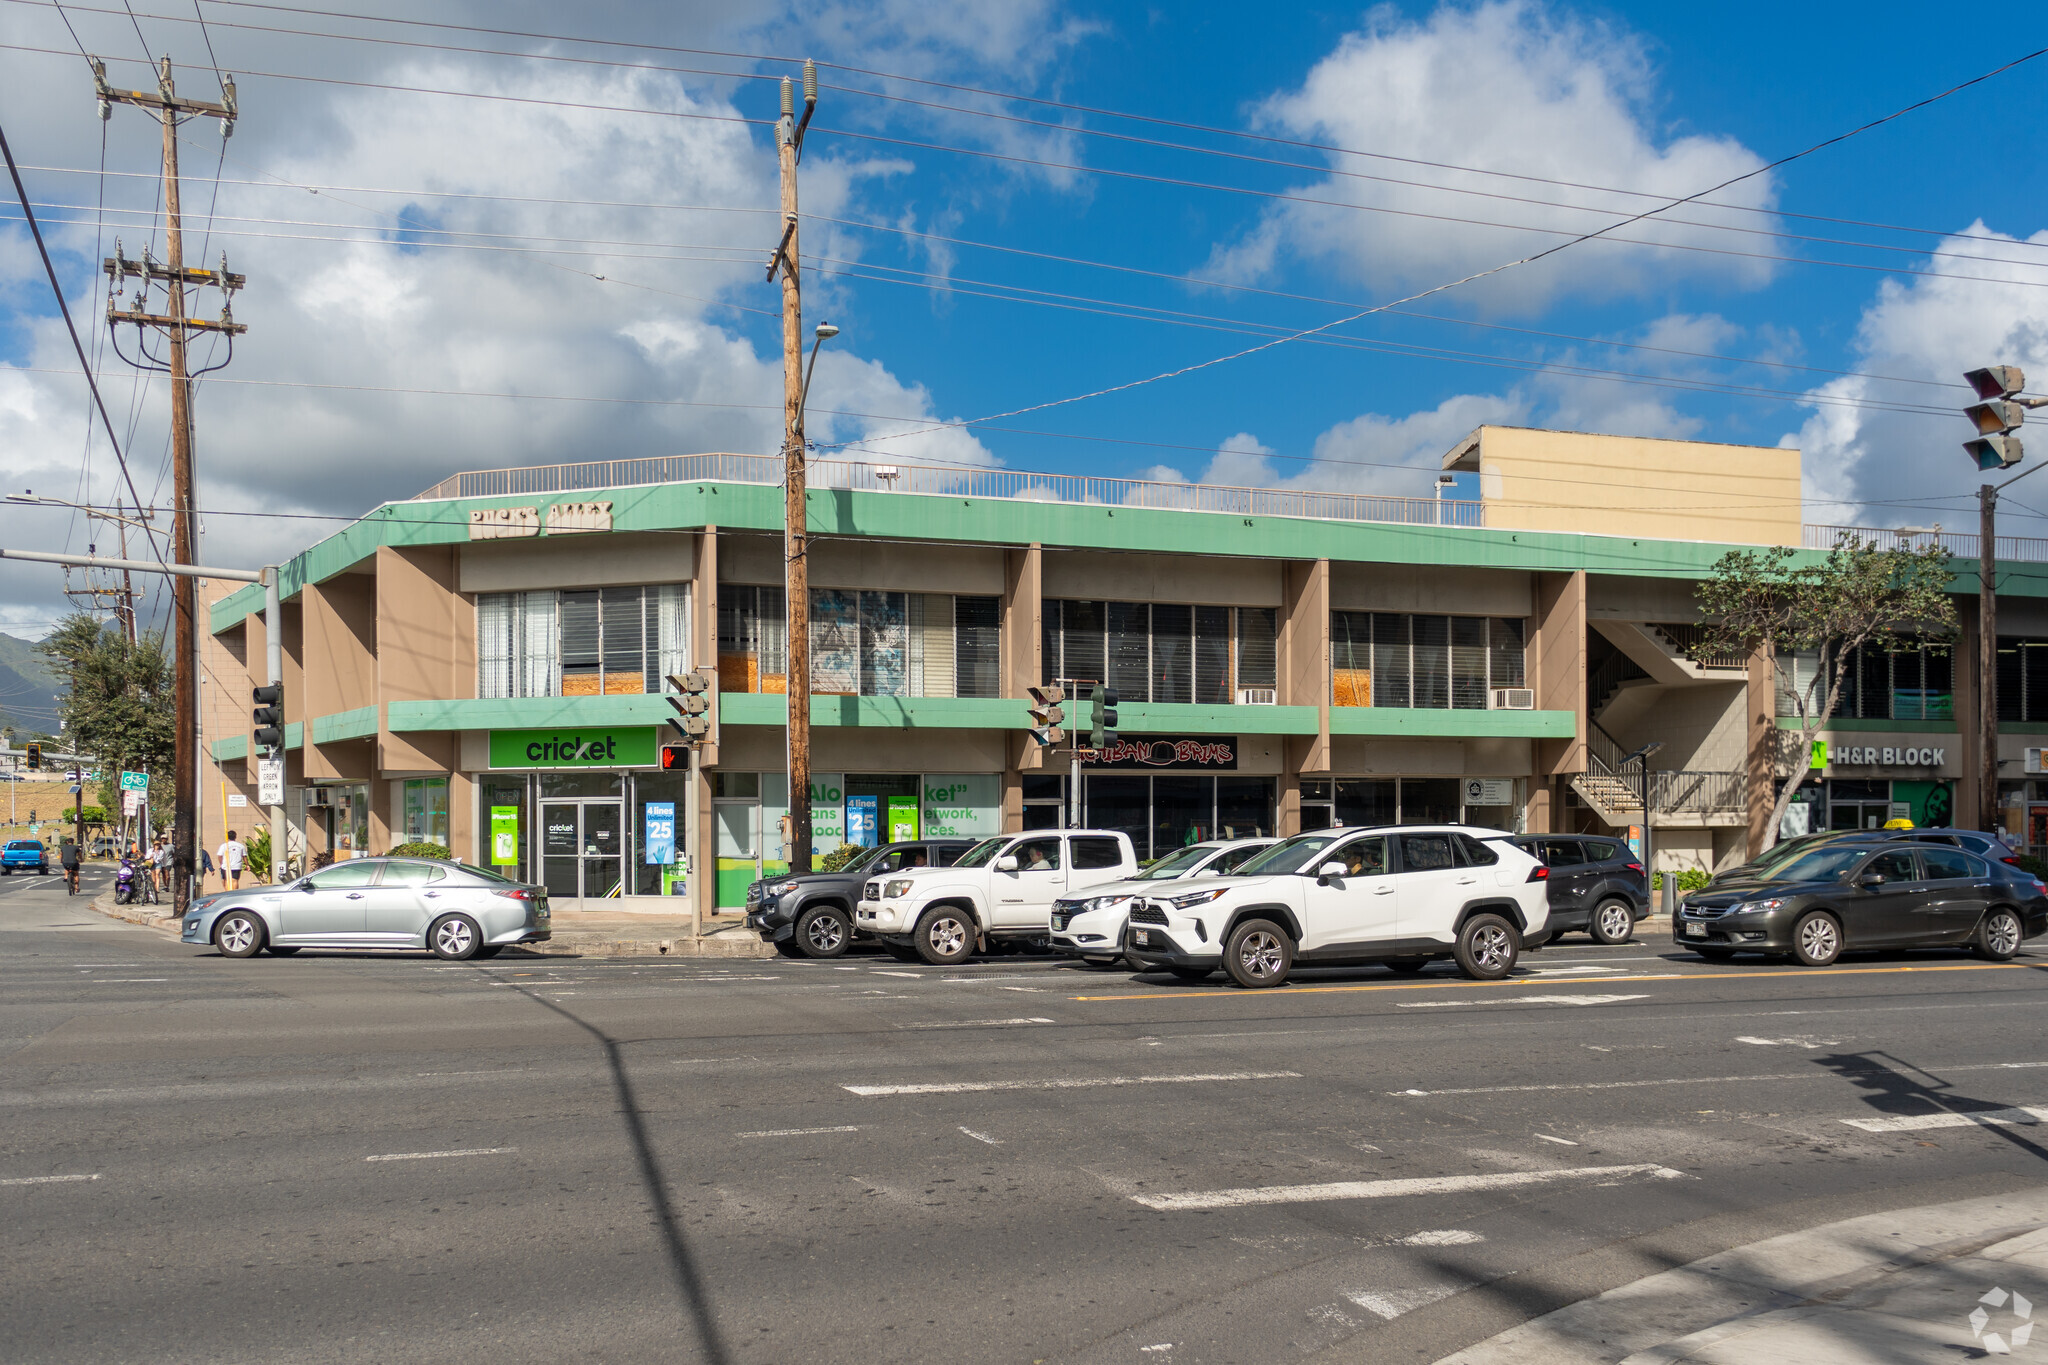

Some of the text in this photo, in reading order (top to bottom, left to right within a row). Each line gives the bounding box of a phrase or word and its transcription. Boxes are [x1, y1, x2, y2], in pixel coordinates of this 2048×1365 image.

[469, 501, 614, 540] PUCK'S ALLEY
[526, 735, 616, 761] cricket
[1175, 740, 1234, 764] BRIMS
[1835, 746, 1945, 766] H&R BLOCK
[261, 763, 281, 771] LEFT ON
[263, 773, 278, 781] GREEN
[264, 792, 277, 801] ONLY
[496, 791, 519, 802] OPEN
[848, 799, 876, 808] 4 lines
[647, 806, 673, 815] 4 lines
[549, 824, 574, 832] cricket
